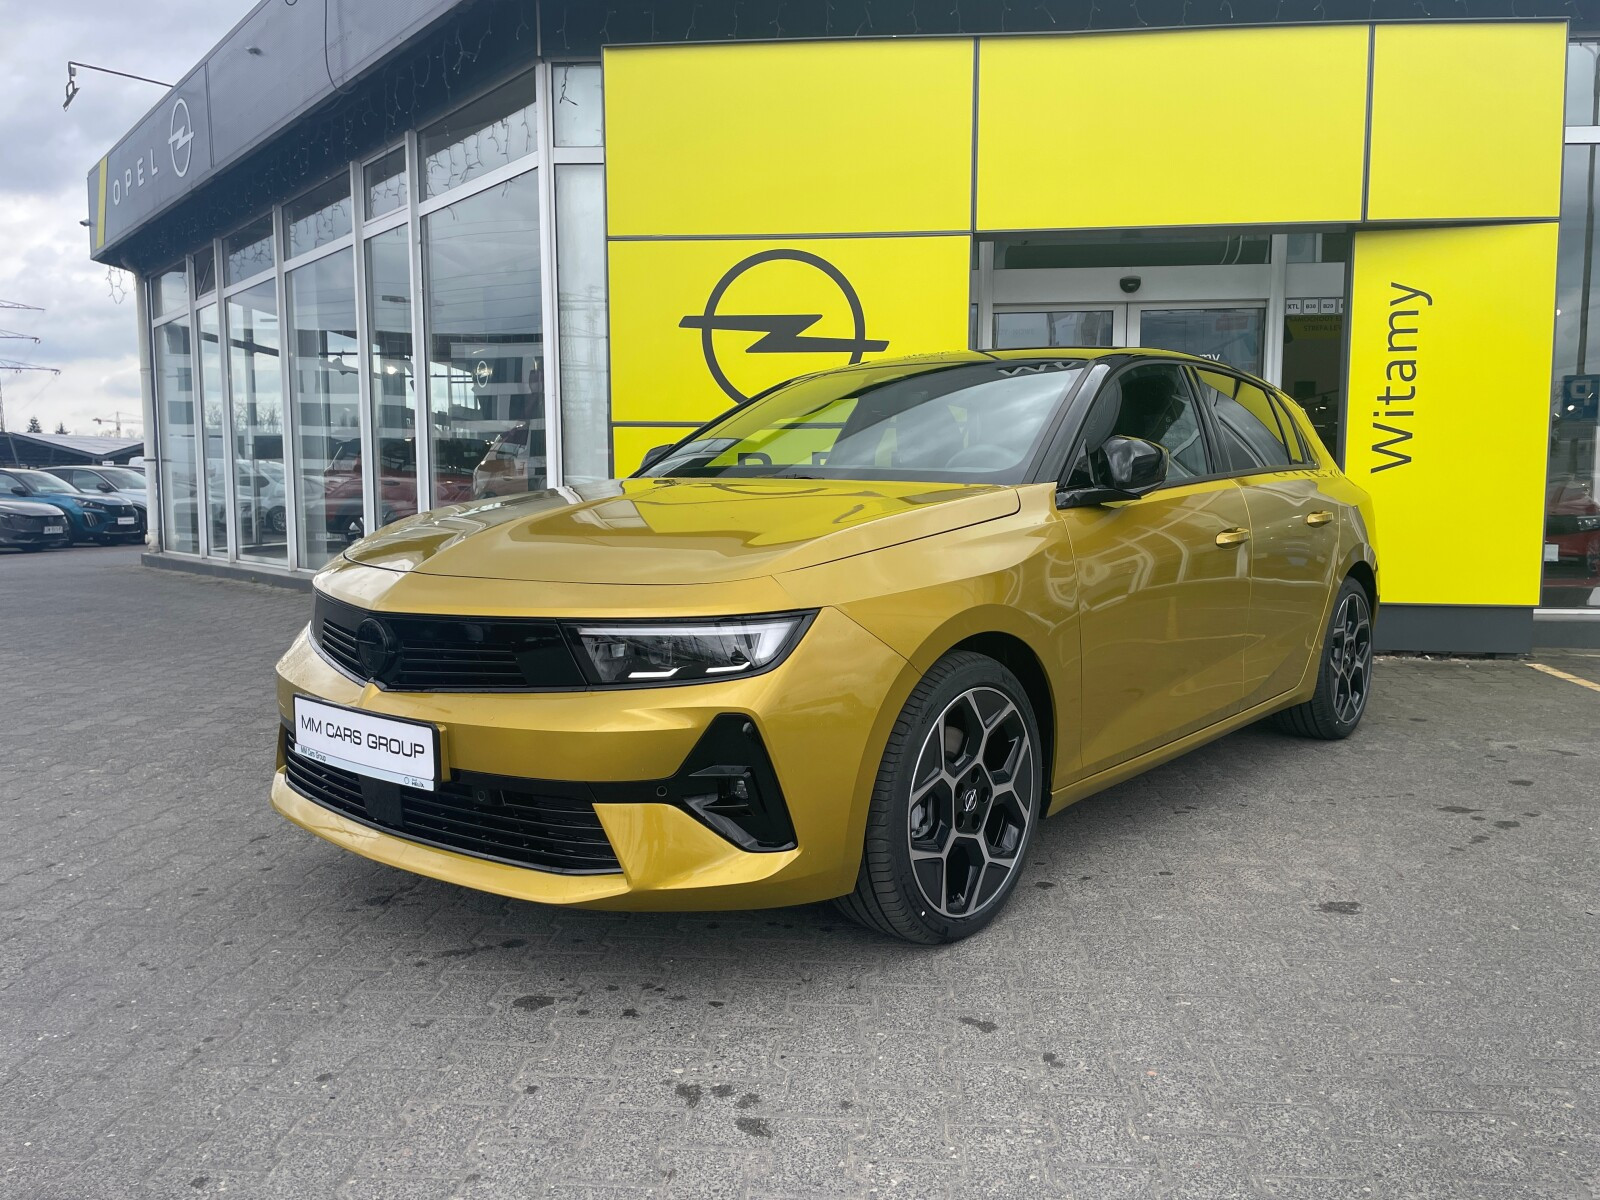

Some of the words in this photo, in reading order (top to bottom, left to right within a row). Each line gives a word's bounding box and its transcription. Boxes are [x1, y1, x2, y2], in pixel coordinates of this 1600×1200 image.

[113, 148, 159, 206] OPEL
[1370, 281, 1433, 474] Witamy
[301, 715, 322, 734] MM
[326, 722, 362, 745] CARS
[367, 733, 424, 758] GROUP
